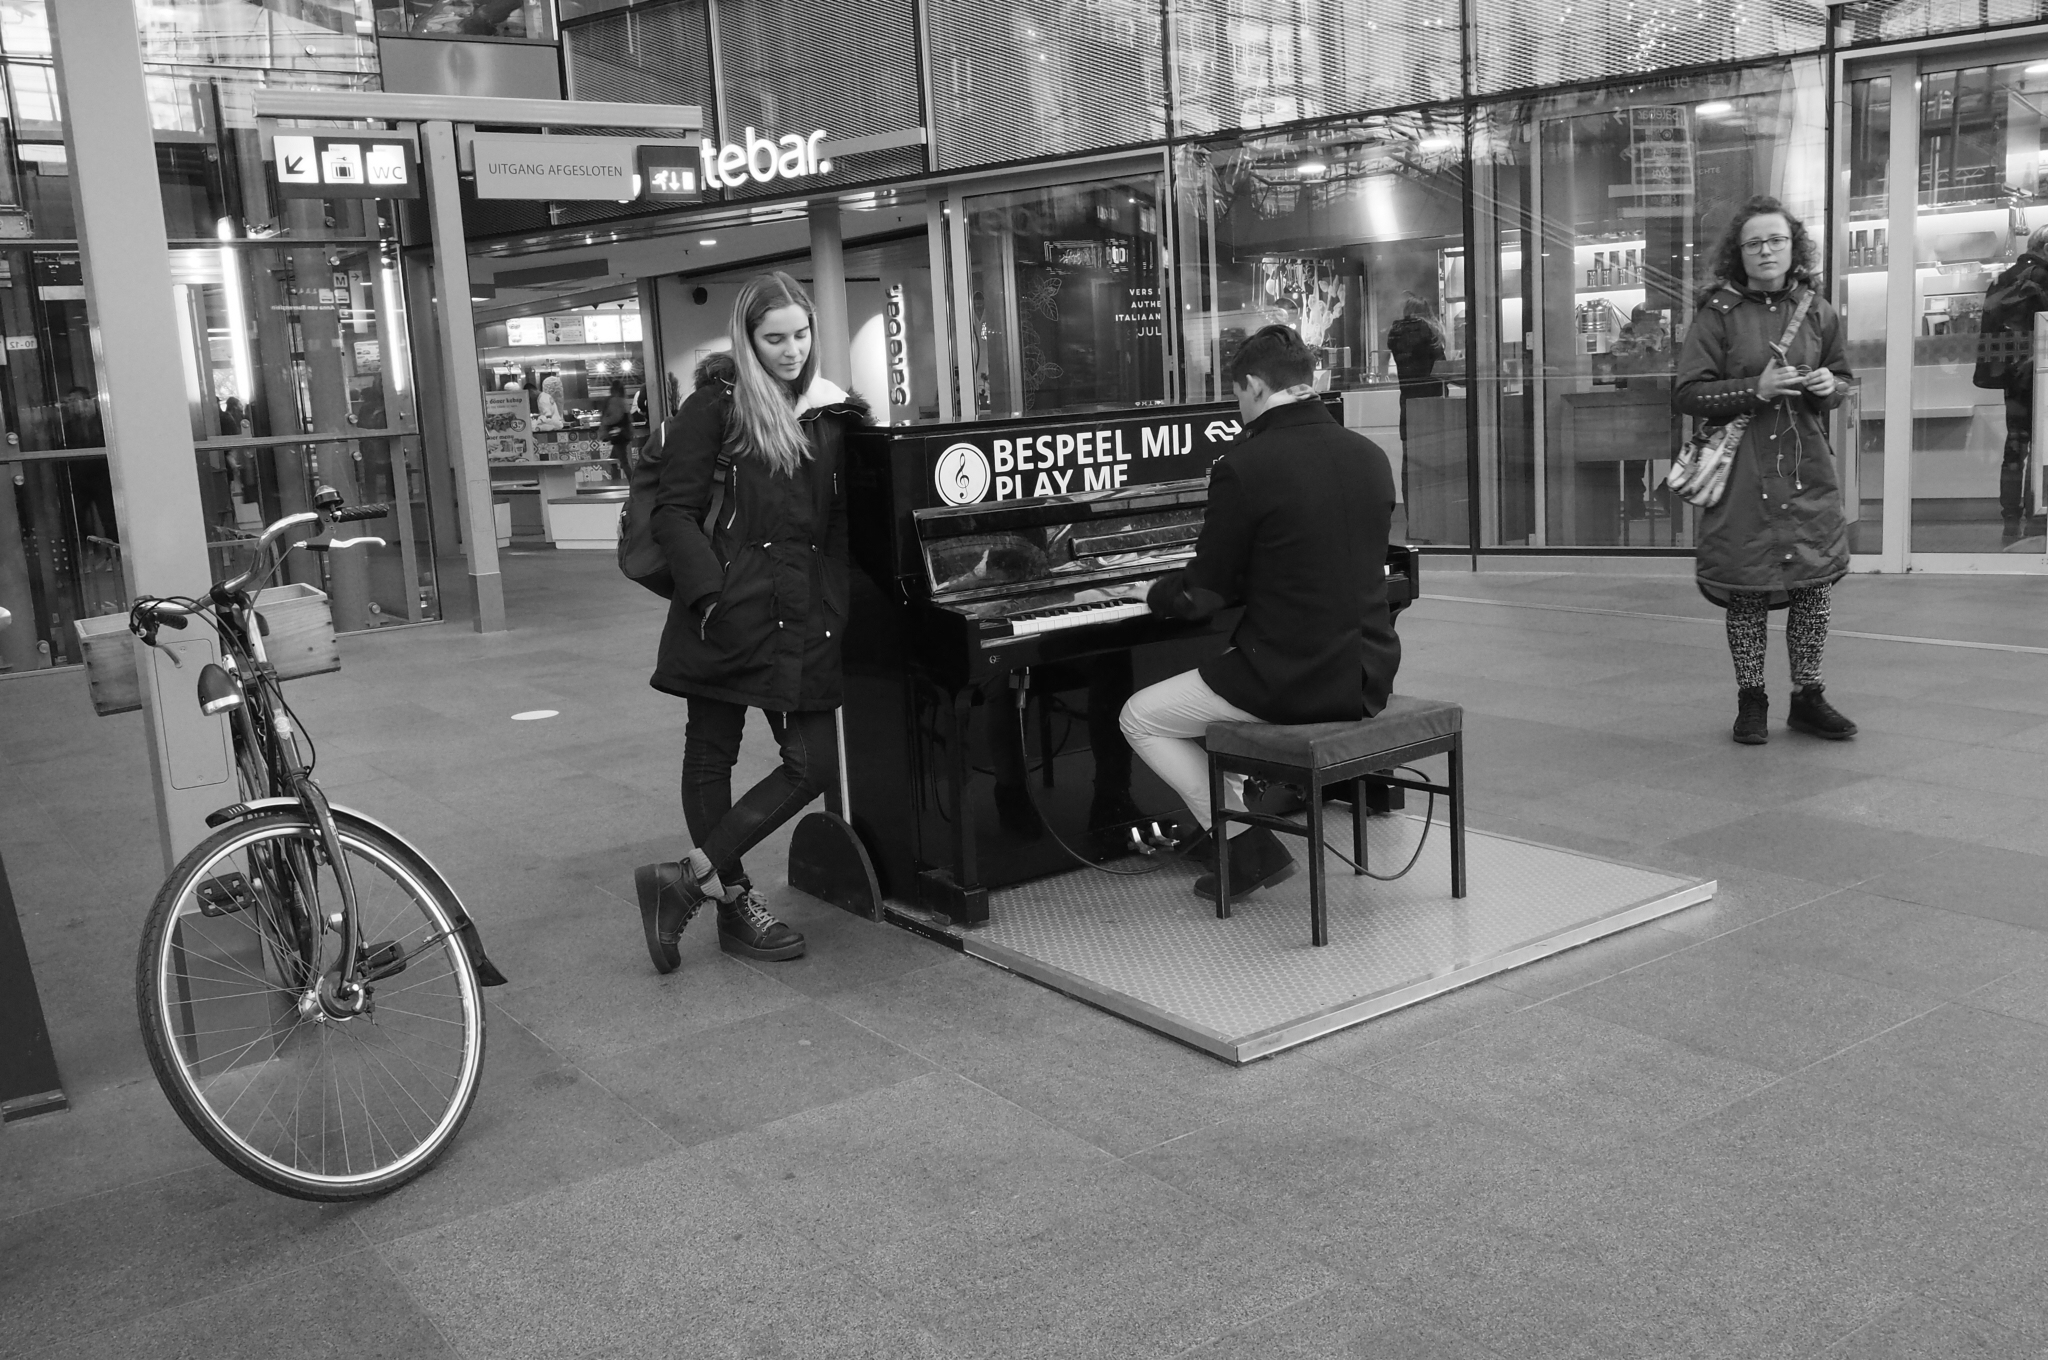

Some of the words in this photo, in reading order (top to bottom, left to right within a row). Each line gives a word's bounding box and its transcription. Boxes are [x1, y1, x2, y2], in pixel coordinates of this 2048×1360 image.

[701, 126, 833, 190] tebar.
[373, 166, 403, 179] WC
[488, 163, 545, 176] UITGANG
[548, 164, 623, 177] AFGESLOTEN
[1129, 288, 1153, 296] VERS
[993, 429, 1132, 473] BESPEEL
[1141, 423, 1193, 459] MIJ
